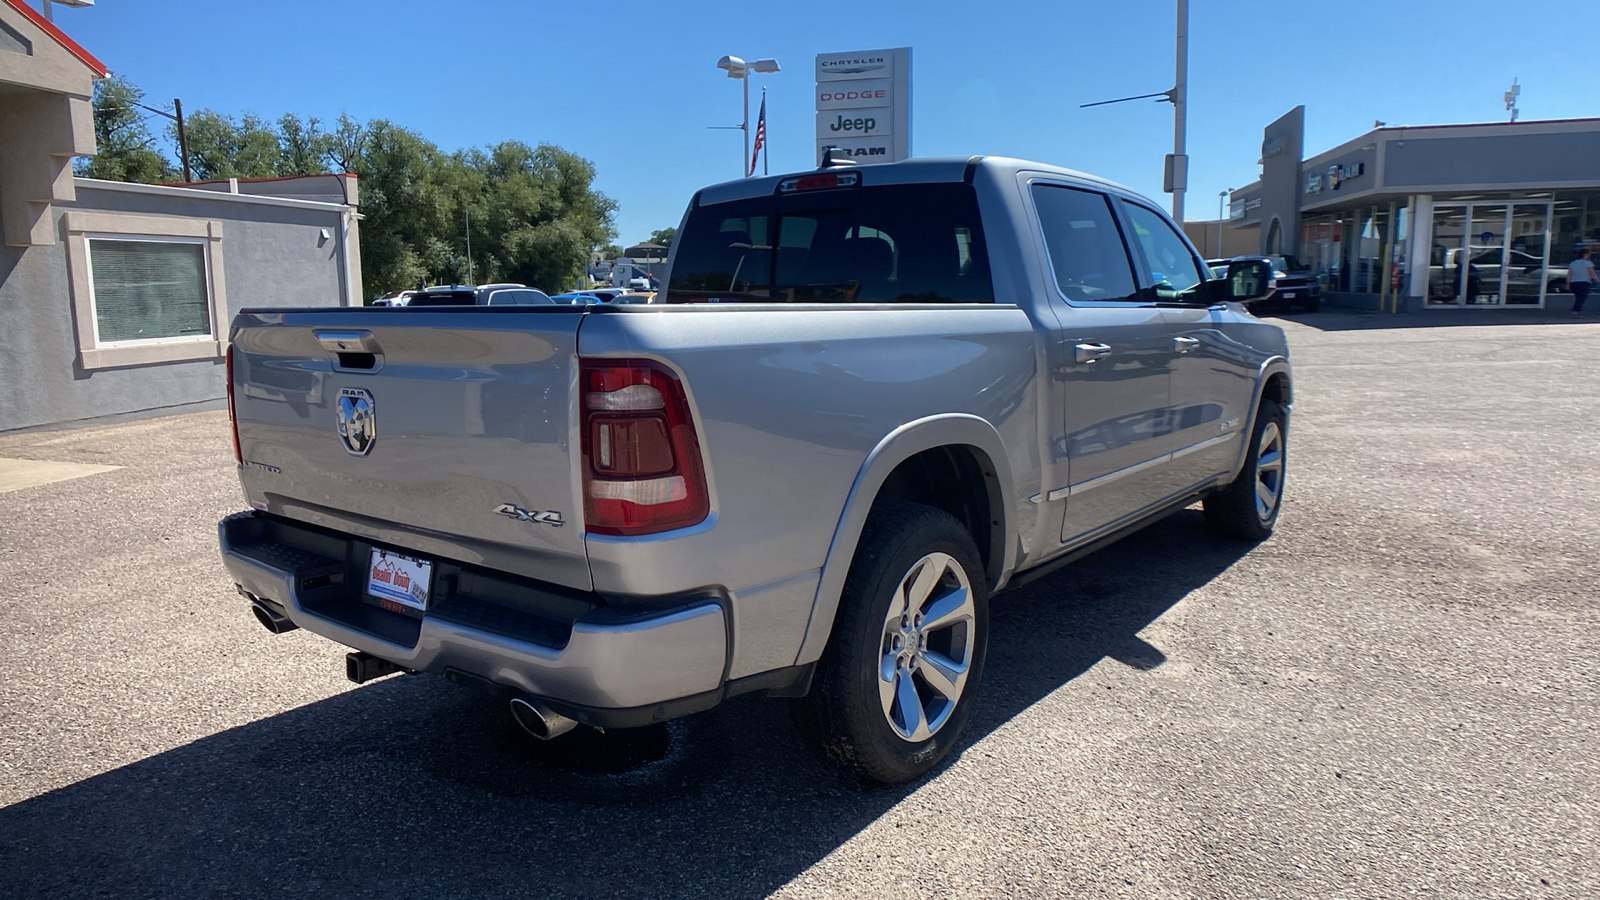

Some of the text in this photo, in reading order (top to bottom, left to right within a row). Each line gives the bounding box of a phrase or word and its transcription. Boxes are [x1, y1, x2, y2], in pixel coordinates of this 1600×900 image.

[822, 58, 884, 66] CHRYSLER
[820, 90, 885, 101] DODGE
[830, 115, 876, 133] Jeep
